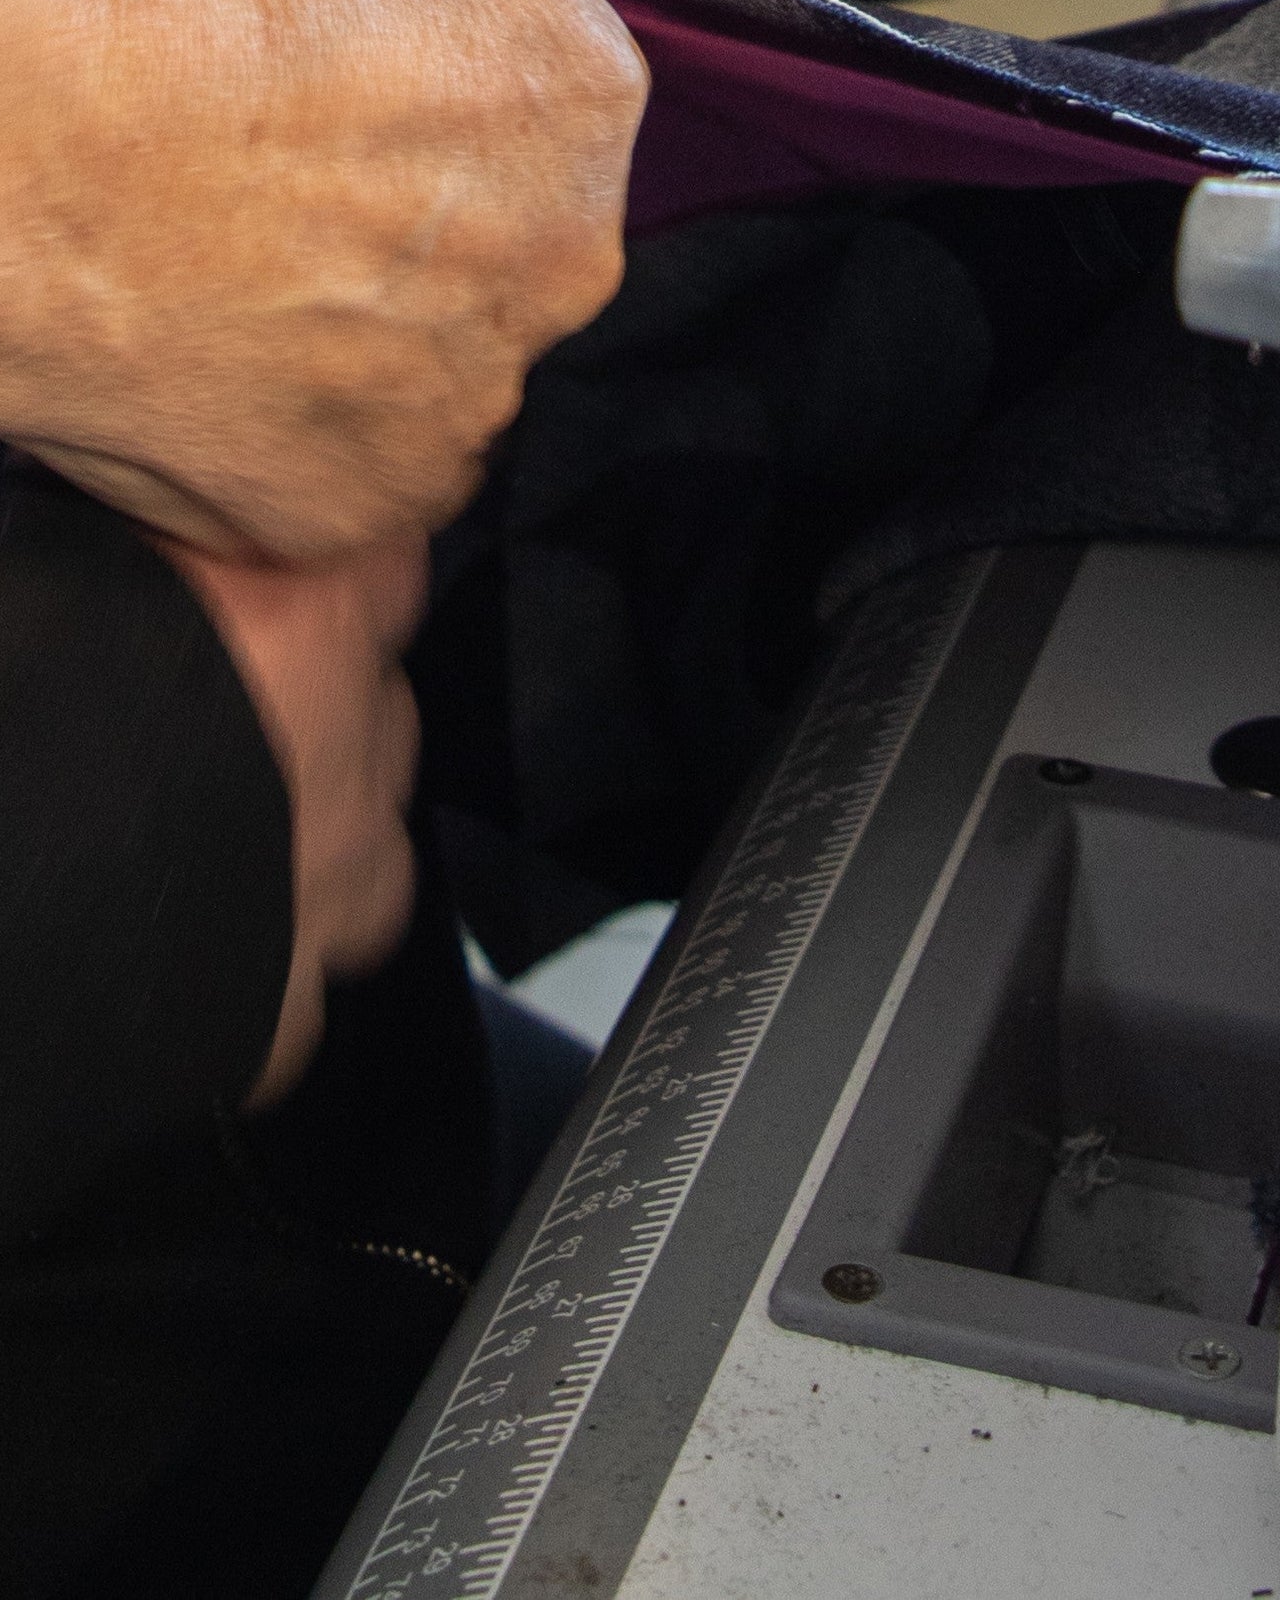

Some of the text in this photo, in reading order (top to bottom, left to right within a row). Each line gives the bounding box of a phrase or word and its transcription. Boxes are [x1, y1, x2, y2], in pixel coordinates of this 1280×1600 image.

[661, 1072, 694, 1101] 25
[619, 1105, 651, 1135] 64
[596, 1148, 628, 1178] 65
[573, 1190, 606, 1221] 66
[554, 1234, 585, 1261] 67
[528, 1279, 561, 1310] 68
[550, 1292, 584, 1318] 27
[504, 1325, 538, 1357] 69
[479, 1371, 515, 1406] 70
[454, 1419, 490, 1452] 71
[487, 1413, 524, 1446] 28
[427, 1468, 466, 1505] 72
[402, 1517, 441, 1555] 73
[421, 1541, 459, 1576] 29
